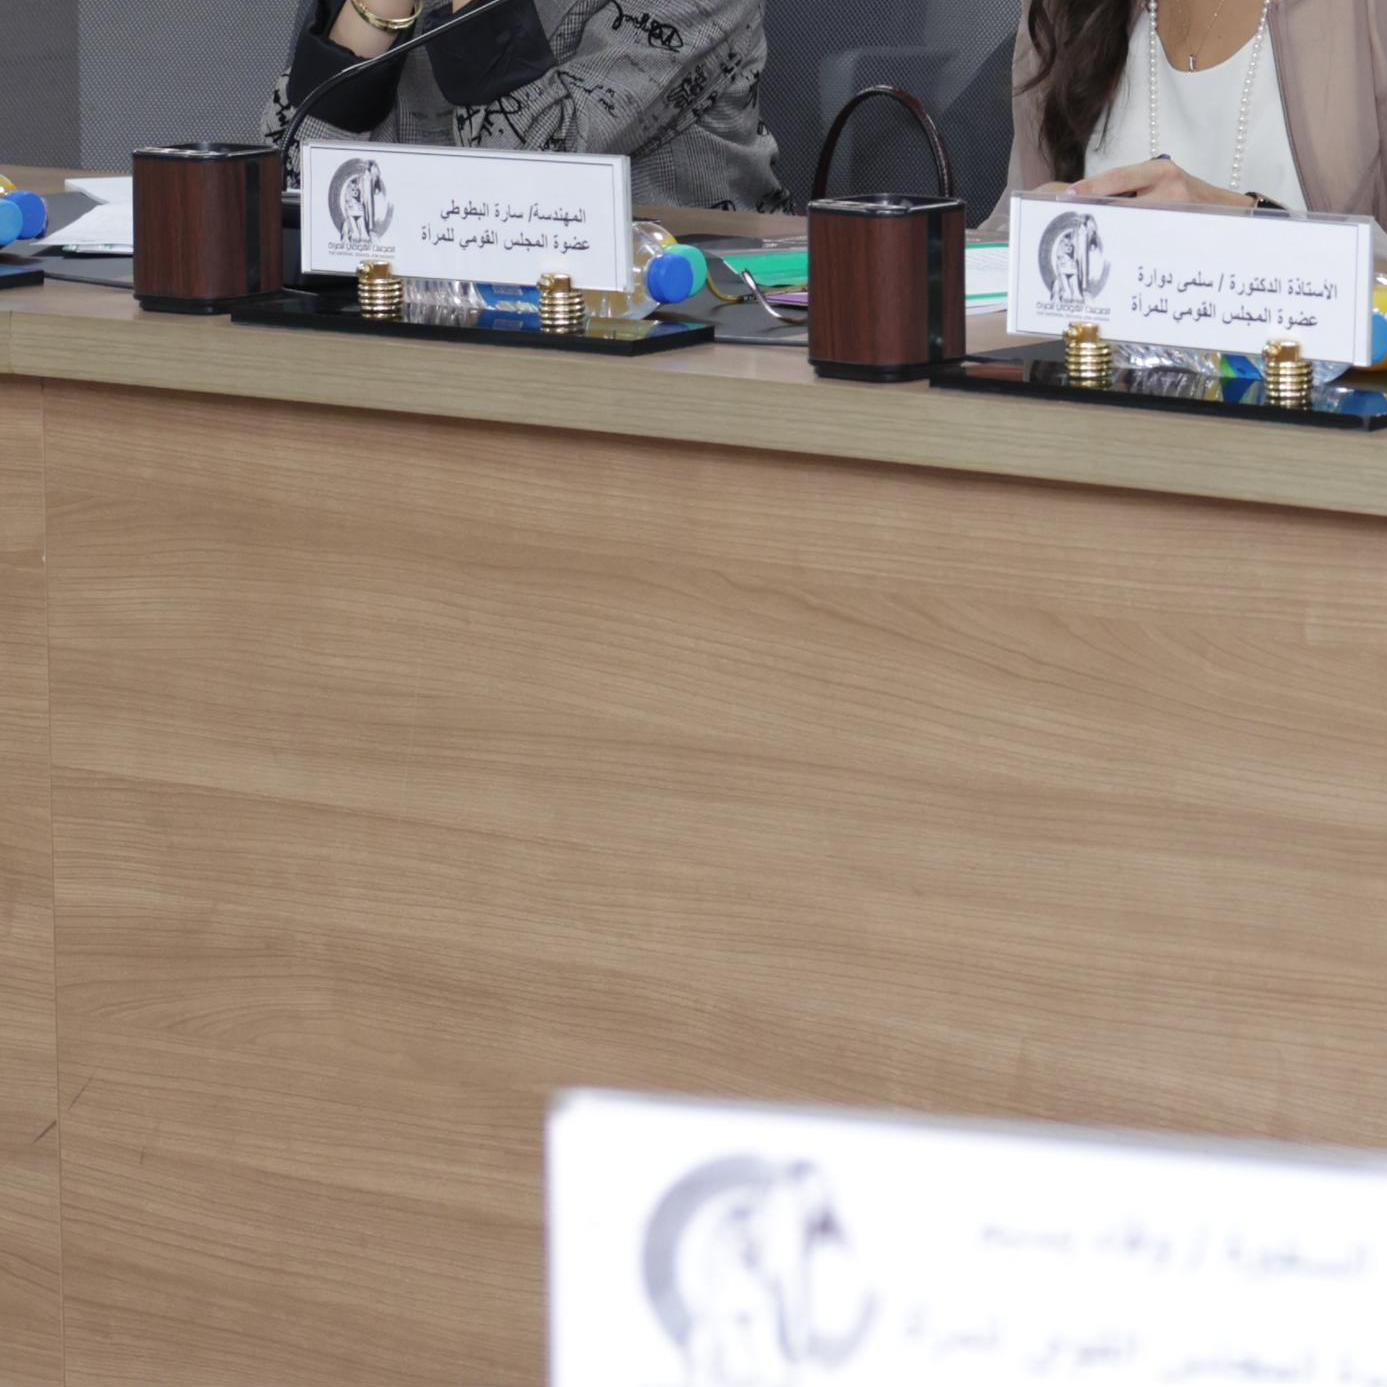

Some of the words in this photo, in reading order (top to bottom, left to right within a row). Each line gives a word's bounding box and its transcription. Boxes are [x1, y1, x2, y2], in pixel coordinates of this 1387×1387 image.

[440, 199, 489, 221] البطوطي
[494, 203, 524, 223] سارة
[528, 203, 586, 227] المهندسة/
[421, 224, 455, 245] للمرأة
[459, 230, 498, 250] القومي
[504, 232, 548, 252] المجلس
[553, 235, 590, 254] عضوة
[1131, 294, 1168, 317] للمرأة
[1173, 302, 1216, 323] القومي
[1222, 305, 1271, 326] المجلس
[1277, 309, 1318, 330] عضوة
